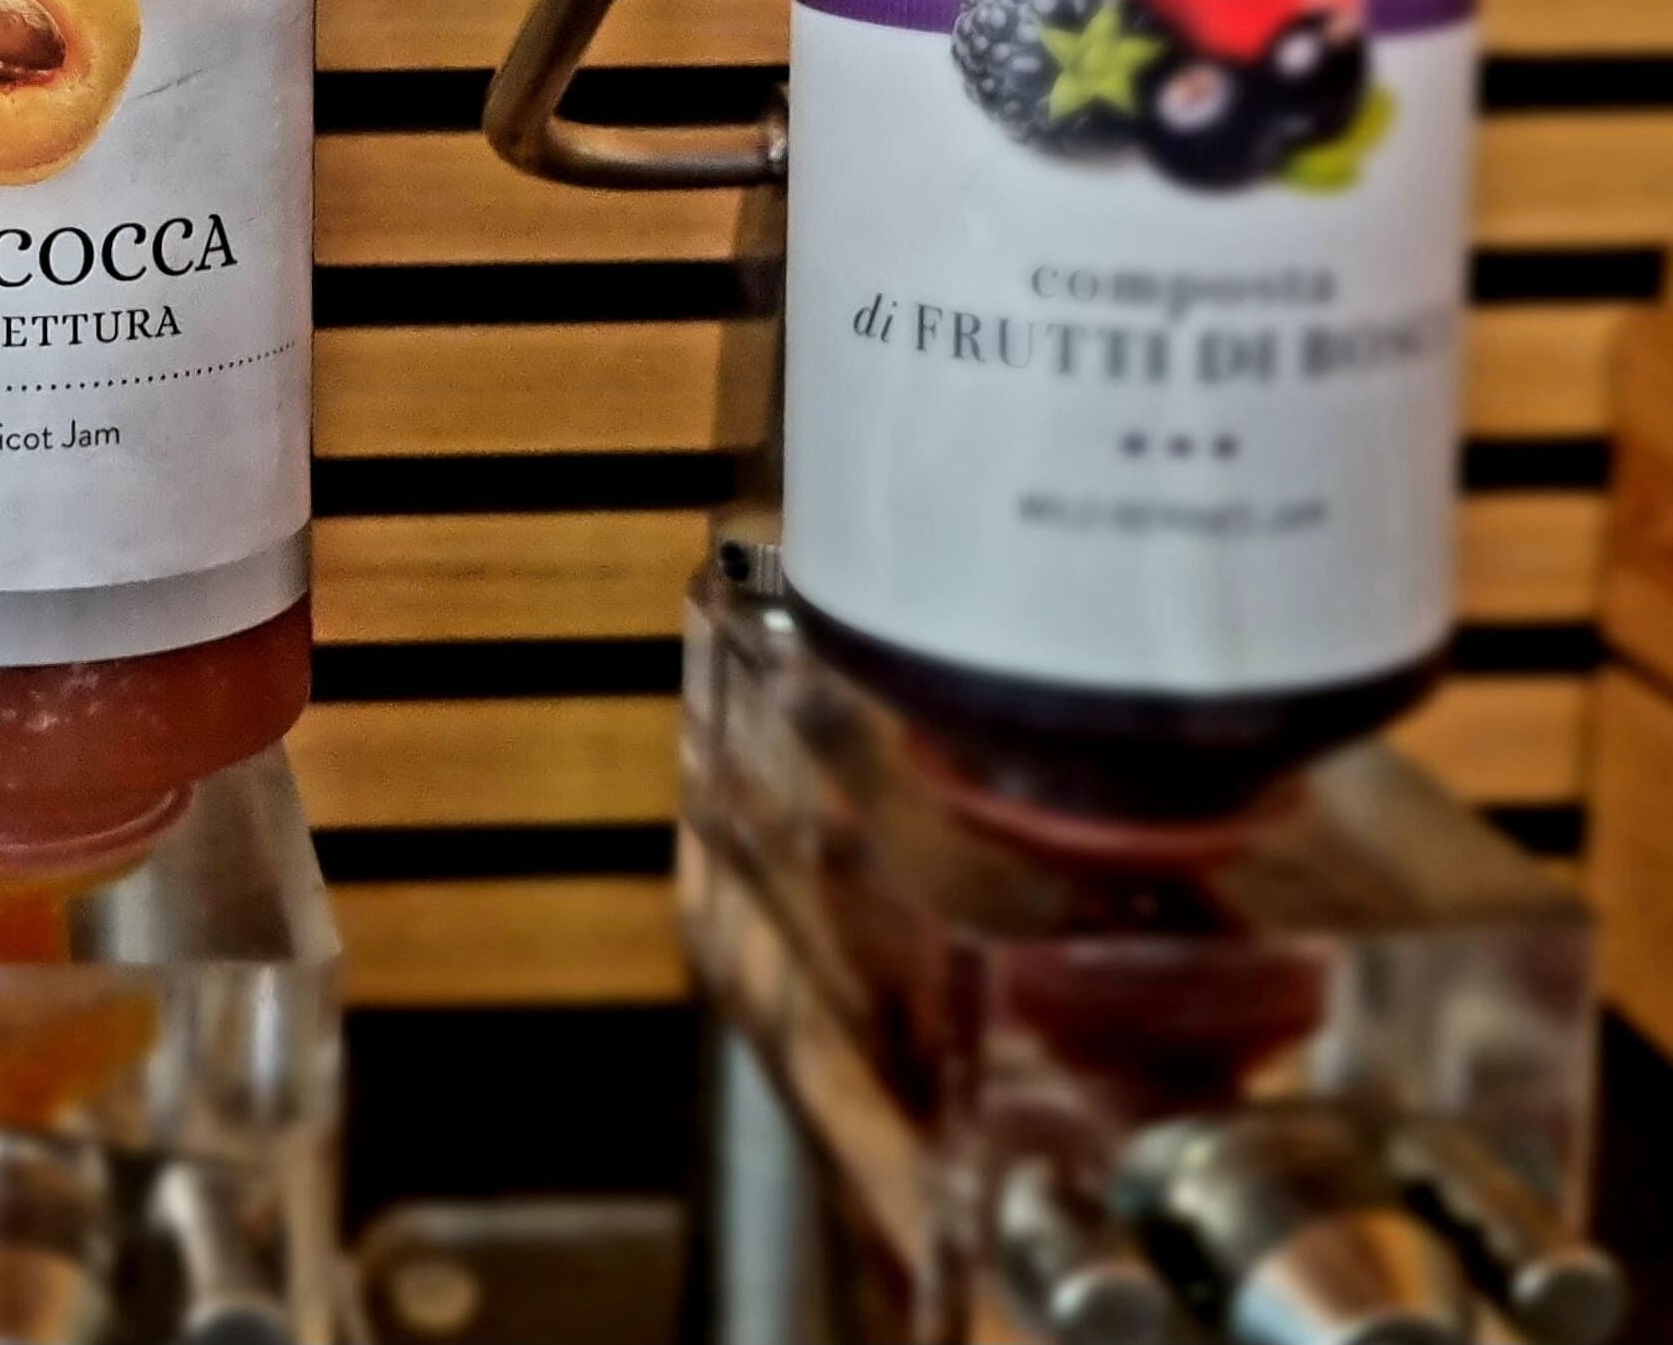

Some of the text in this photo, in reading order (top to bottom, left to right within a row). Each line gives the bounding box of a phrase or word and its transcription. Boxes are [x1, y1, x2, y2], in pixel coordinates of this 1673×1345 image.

[851, 291, 898, 343] di
[912, 302, 1172, 385] FRUTTI
[1193, 322, 1278, 387] DI
[61, 419, 121, 451] Jam
